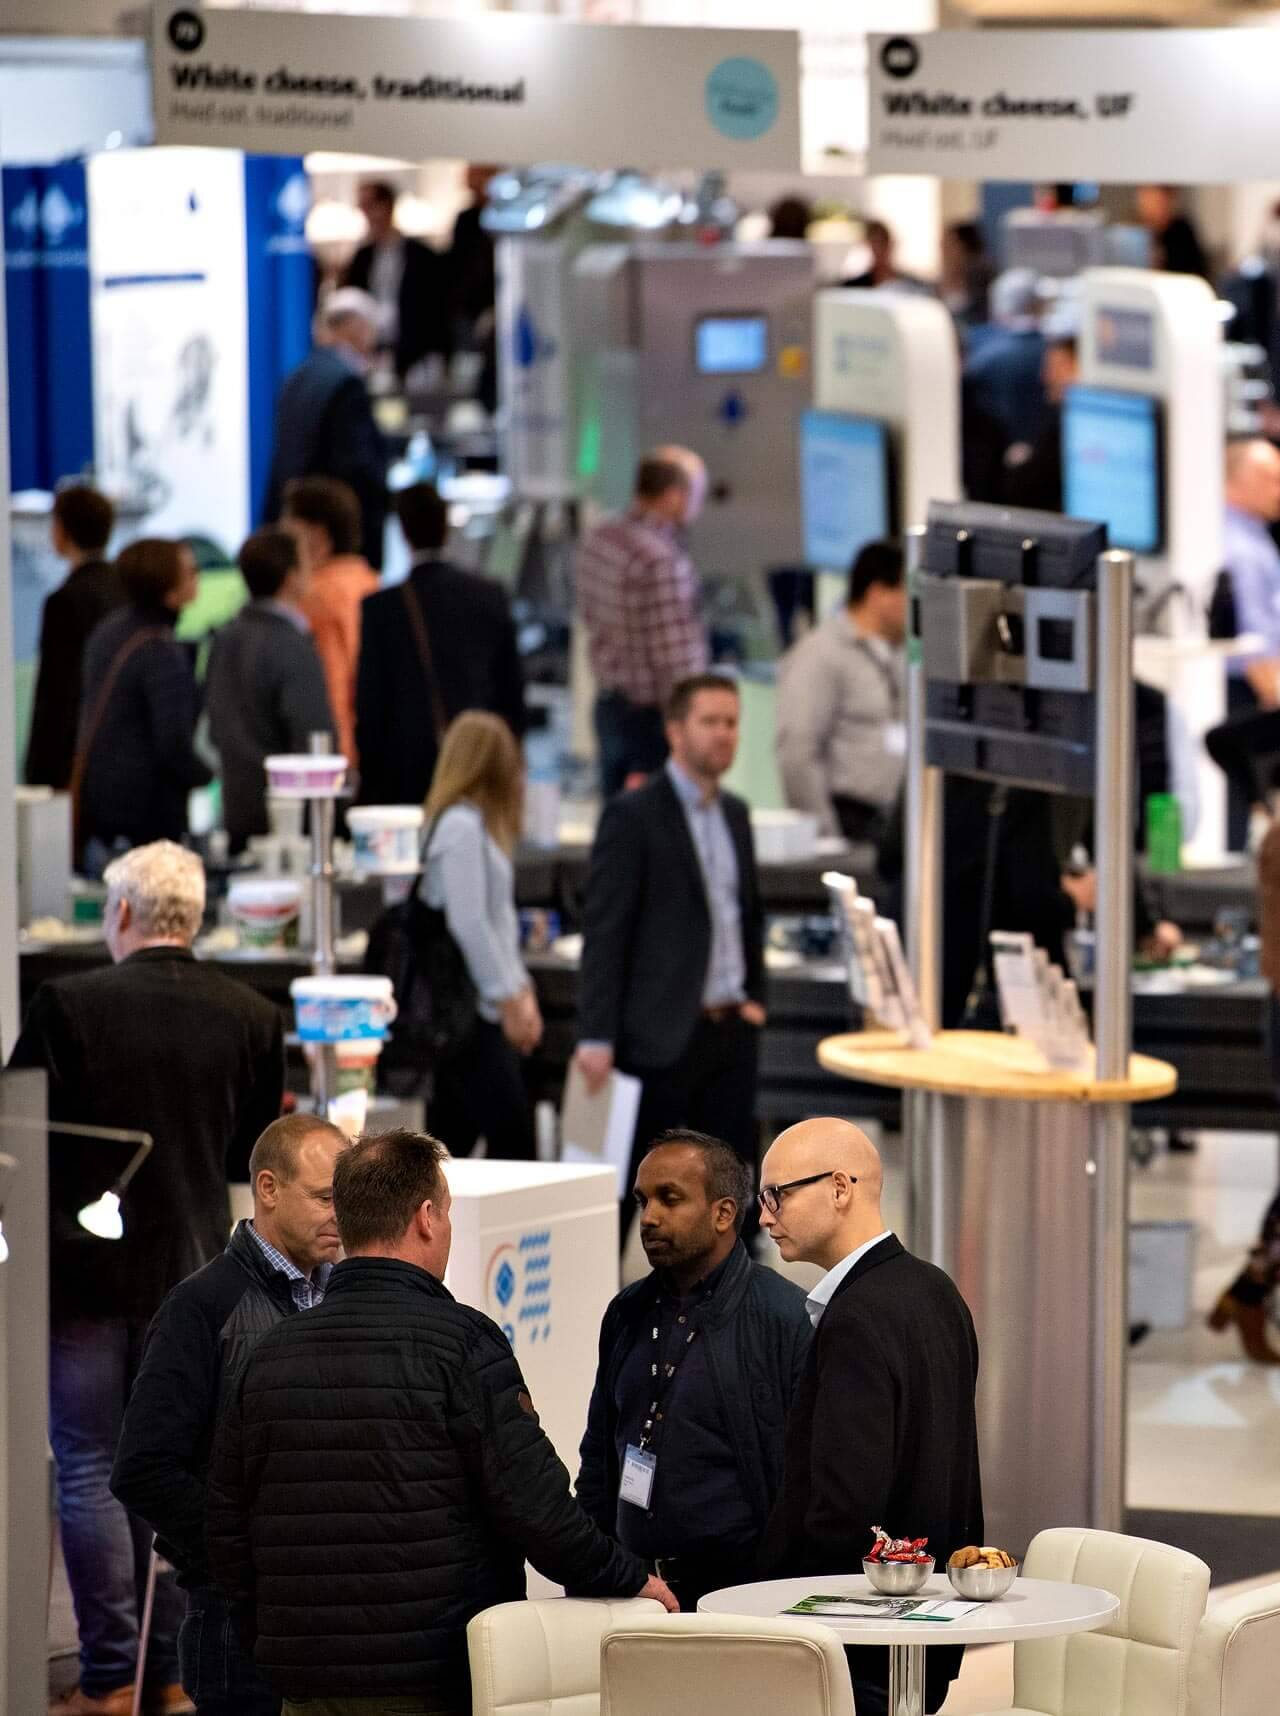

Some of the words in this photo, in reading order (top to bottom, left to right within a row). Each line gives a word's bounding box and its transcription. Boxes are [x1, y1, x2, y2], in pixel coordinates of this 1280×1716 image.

[171, 63, 255, 94] White
[264, 67, 366, 99] cheese,
[372, 74, 525, 103] traditional
[882, 90, 972, 117] White
[982, 88, 1088, 120] cheese,
[1095, 92, 1135, 118] UF
